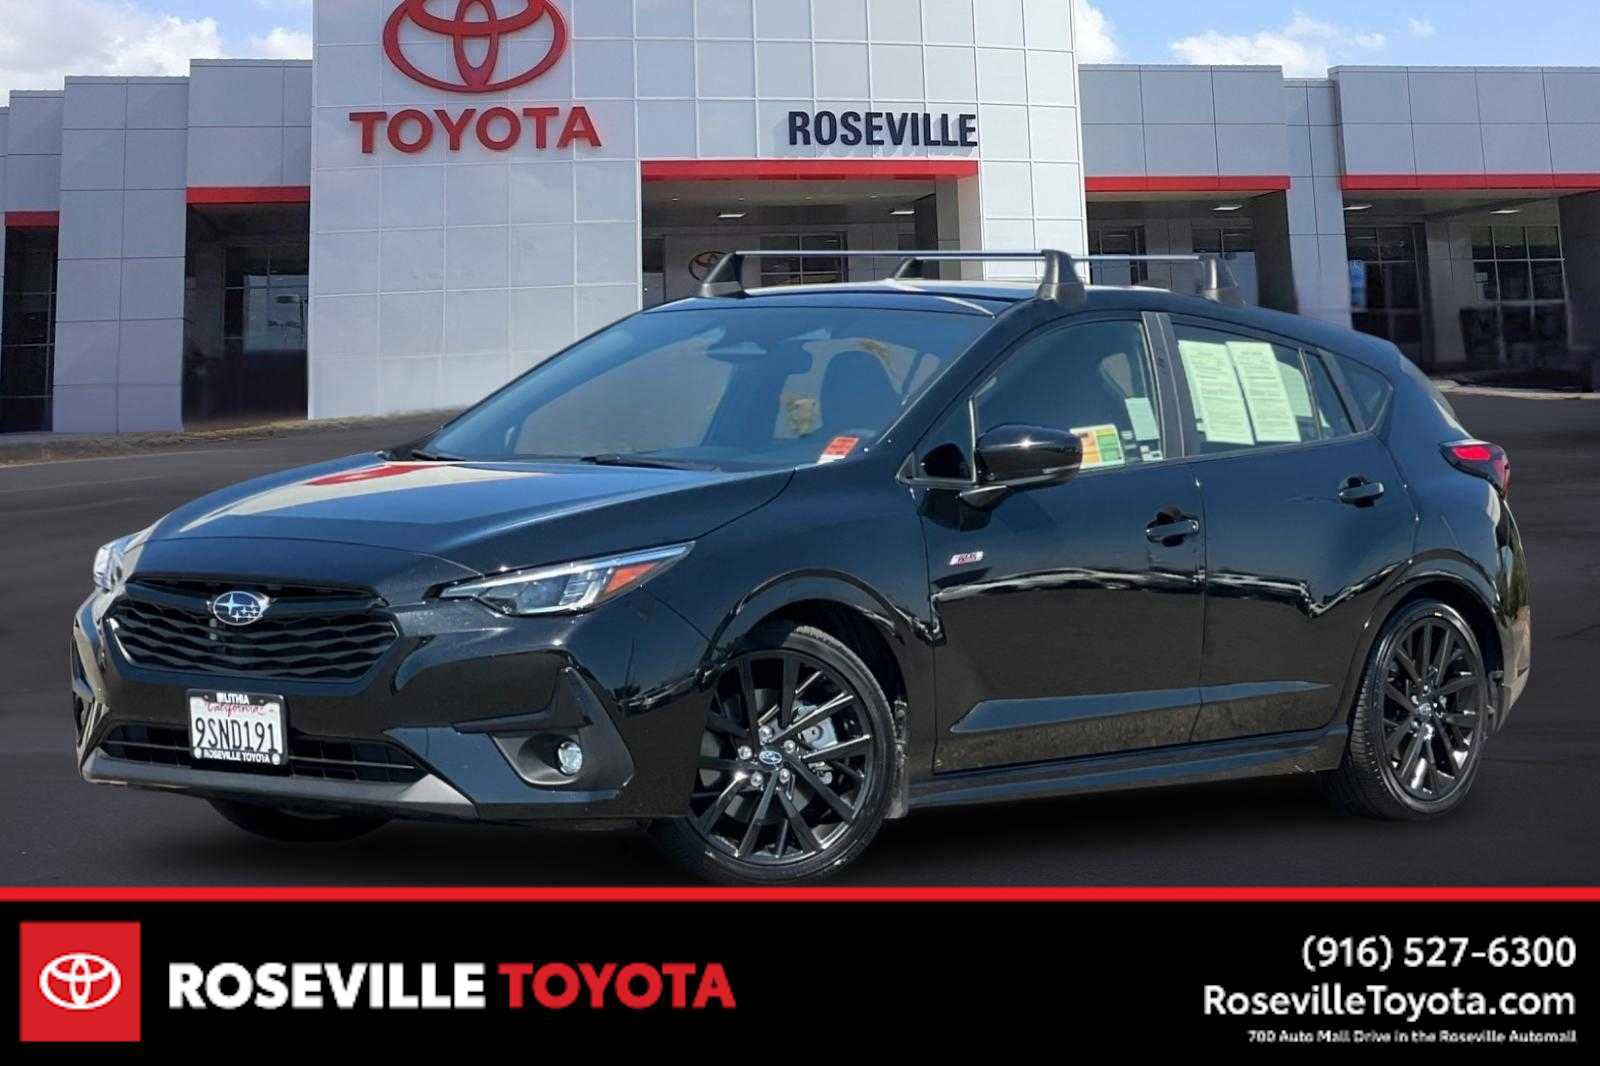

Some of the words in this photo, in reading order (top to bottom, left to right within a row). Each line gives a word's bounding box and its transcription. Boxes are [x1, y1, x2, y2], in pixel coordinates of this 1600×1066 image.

[349, 106, 602, 154] TOYOTA
[788, 111, 978, 147] ROSEVILLE
[195, 717, 279, 754] 9SND191
[203, 749, 242, 761] ROSEVILLE
[242, 752, 271, 763] TOYOTA
